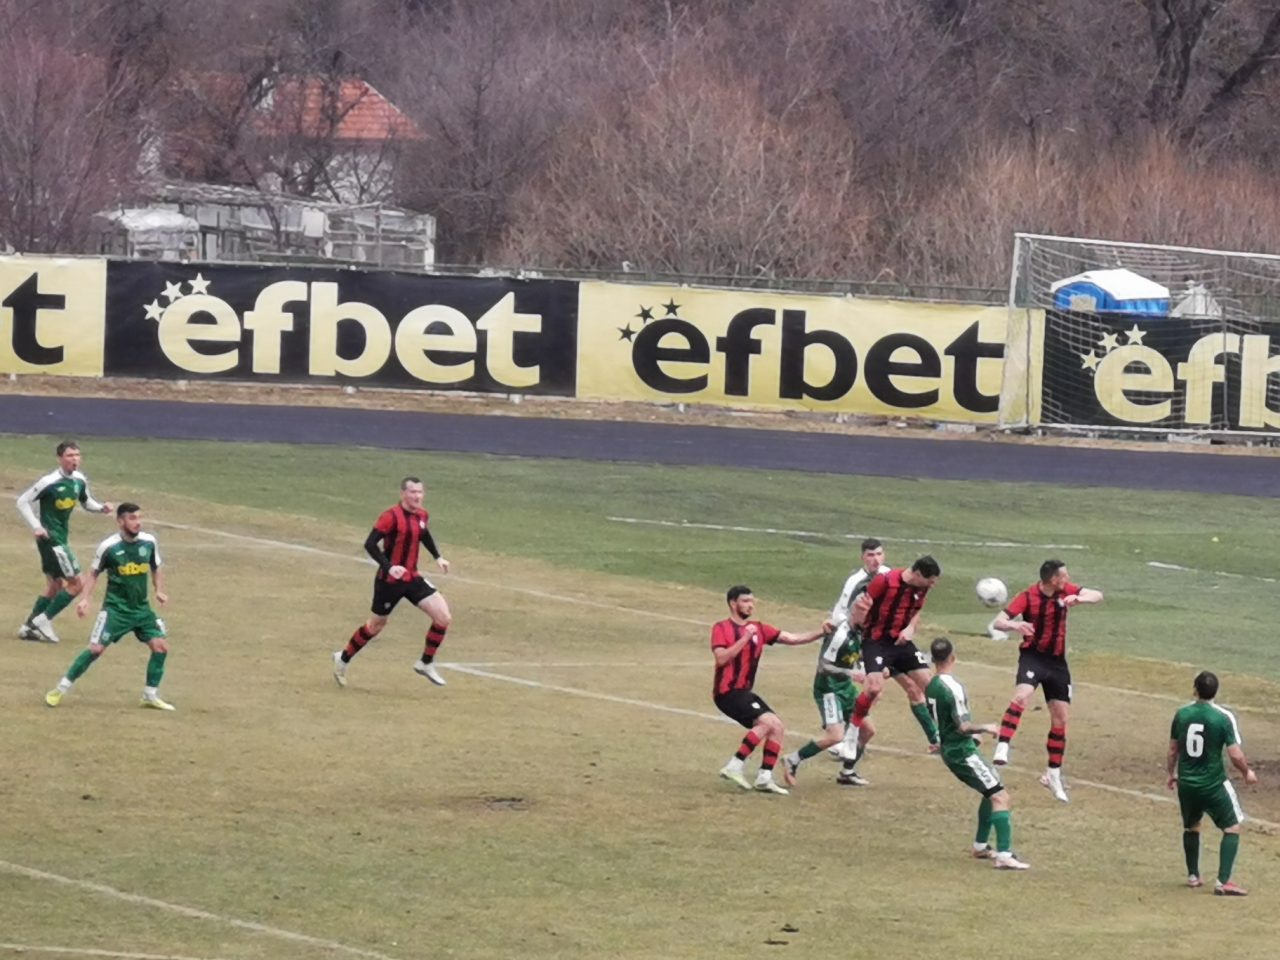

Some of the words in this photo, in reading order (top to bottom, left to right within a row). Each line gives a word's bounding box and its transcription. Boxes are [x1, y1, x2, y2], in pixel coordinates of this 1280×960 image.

[2, 271, 66, 366] t
[157, 281, 542, 388] efbet
[632, 308, 1005, 413] efbet
[1186, 723, 1204, 758] 6
